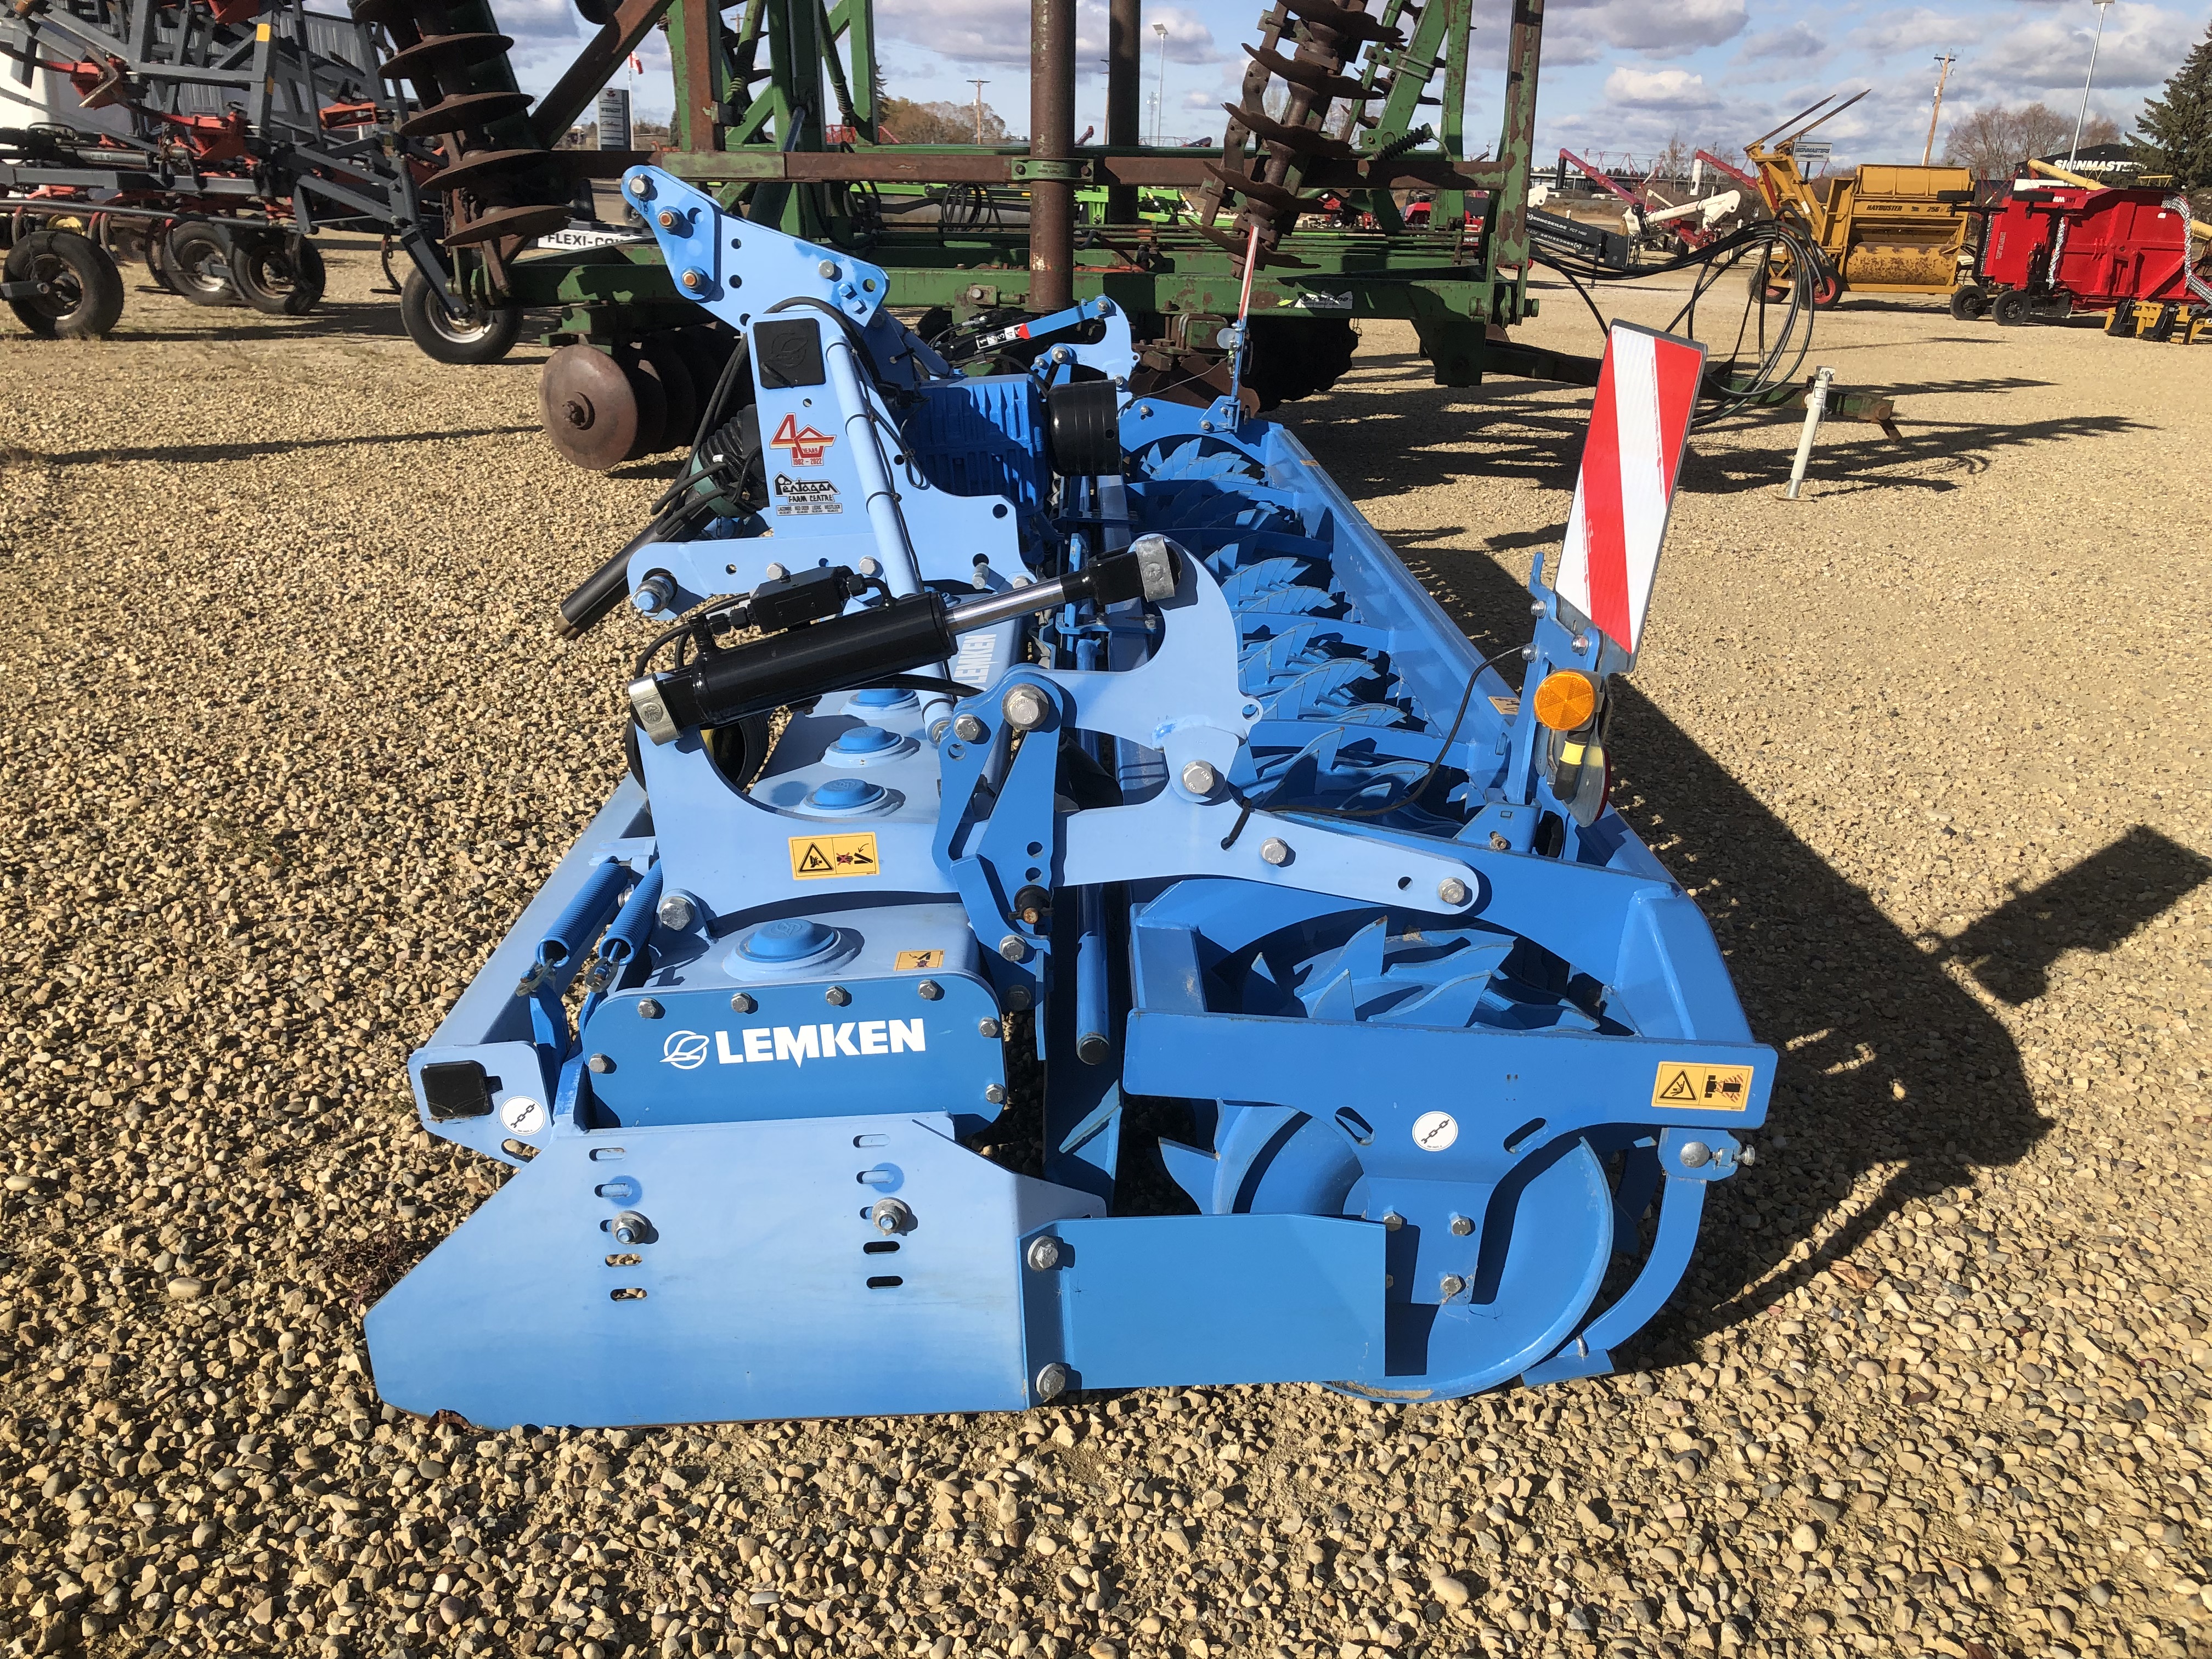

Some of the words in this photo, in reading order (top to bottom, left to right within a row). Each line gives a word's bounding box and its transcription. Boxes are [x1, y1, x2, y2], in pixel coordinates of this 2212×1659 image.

[774, 473, 838, 495] Pentagon
[953, 634, 1000, 683] LEMKEN
[715, 1018, 926, 1068] LEMKEN
